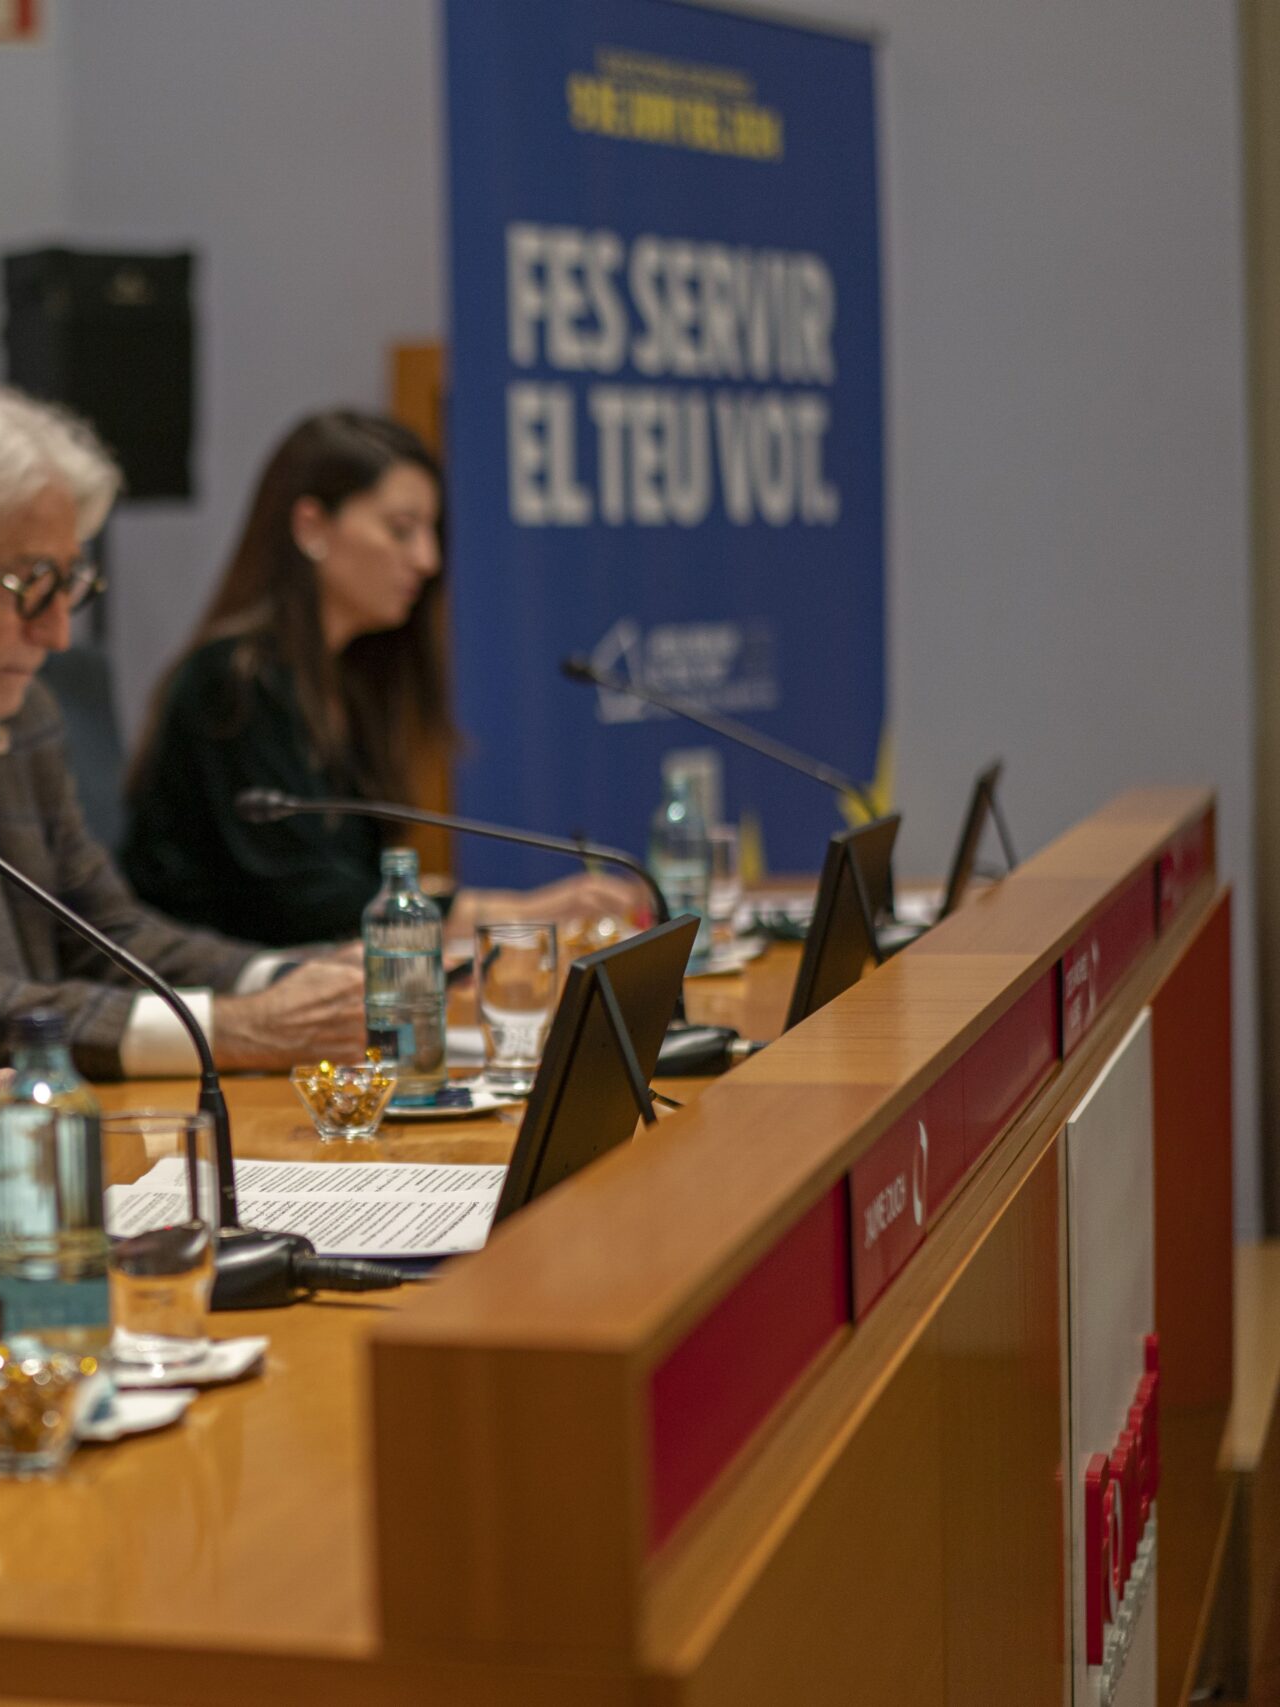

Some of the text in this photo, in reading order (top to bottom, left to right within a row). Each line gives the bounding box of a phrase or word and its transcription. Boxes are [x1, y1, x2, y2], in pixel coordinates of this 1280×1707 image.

[507, 223, 834, 385] FES SERVIR
[507, 382, 838, 526] EL TEU VOT.
